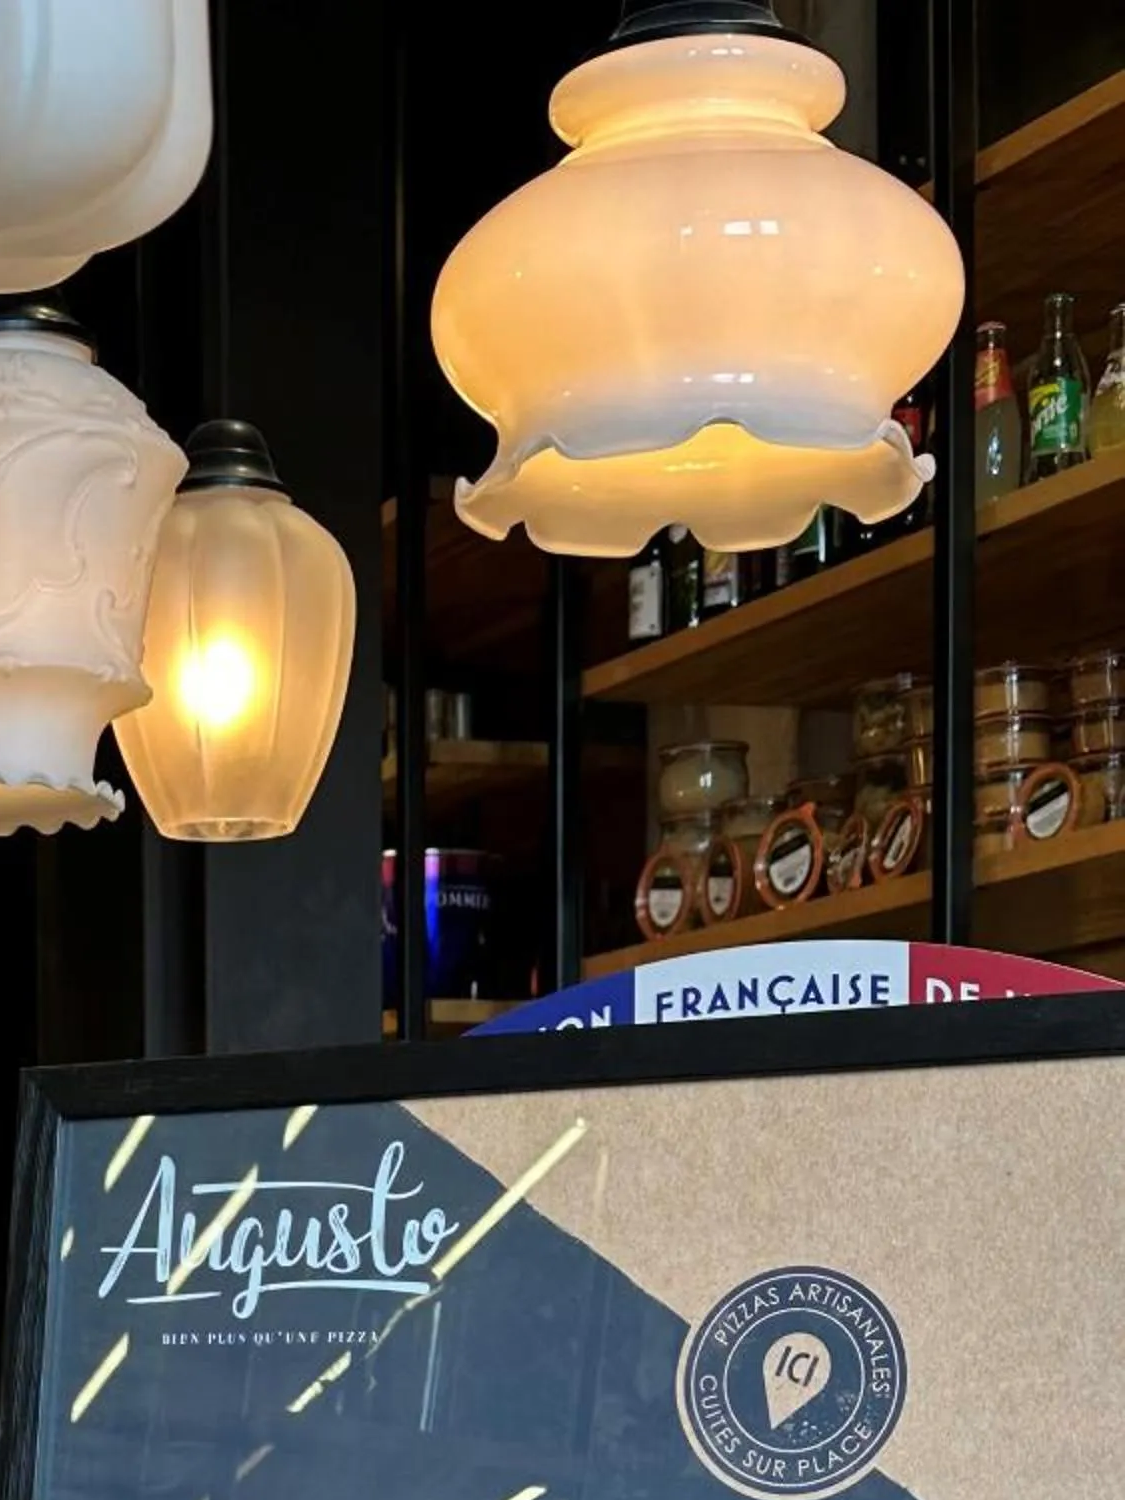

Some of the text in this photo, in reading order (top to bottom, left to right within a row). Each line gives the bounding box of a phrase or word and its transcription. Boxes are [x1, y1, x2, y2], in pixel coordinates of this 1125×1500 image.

[656, 973, 889, 1024] FRANÇAISE
[98, 1141, 460, 1319] Augusto
[208, 1331, 246, 1344] PLUS
[715, 1282, 891, 1393] PIZZAS ARTISANALES
[775, 1346, 819, 1387] ICI
[699, 1375, 873, 1478] CUITES SUR PLACE
